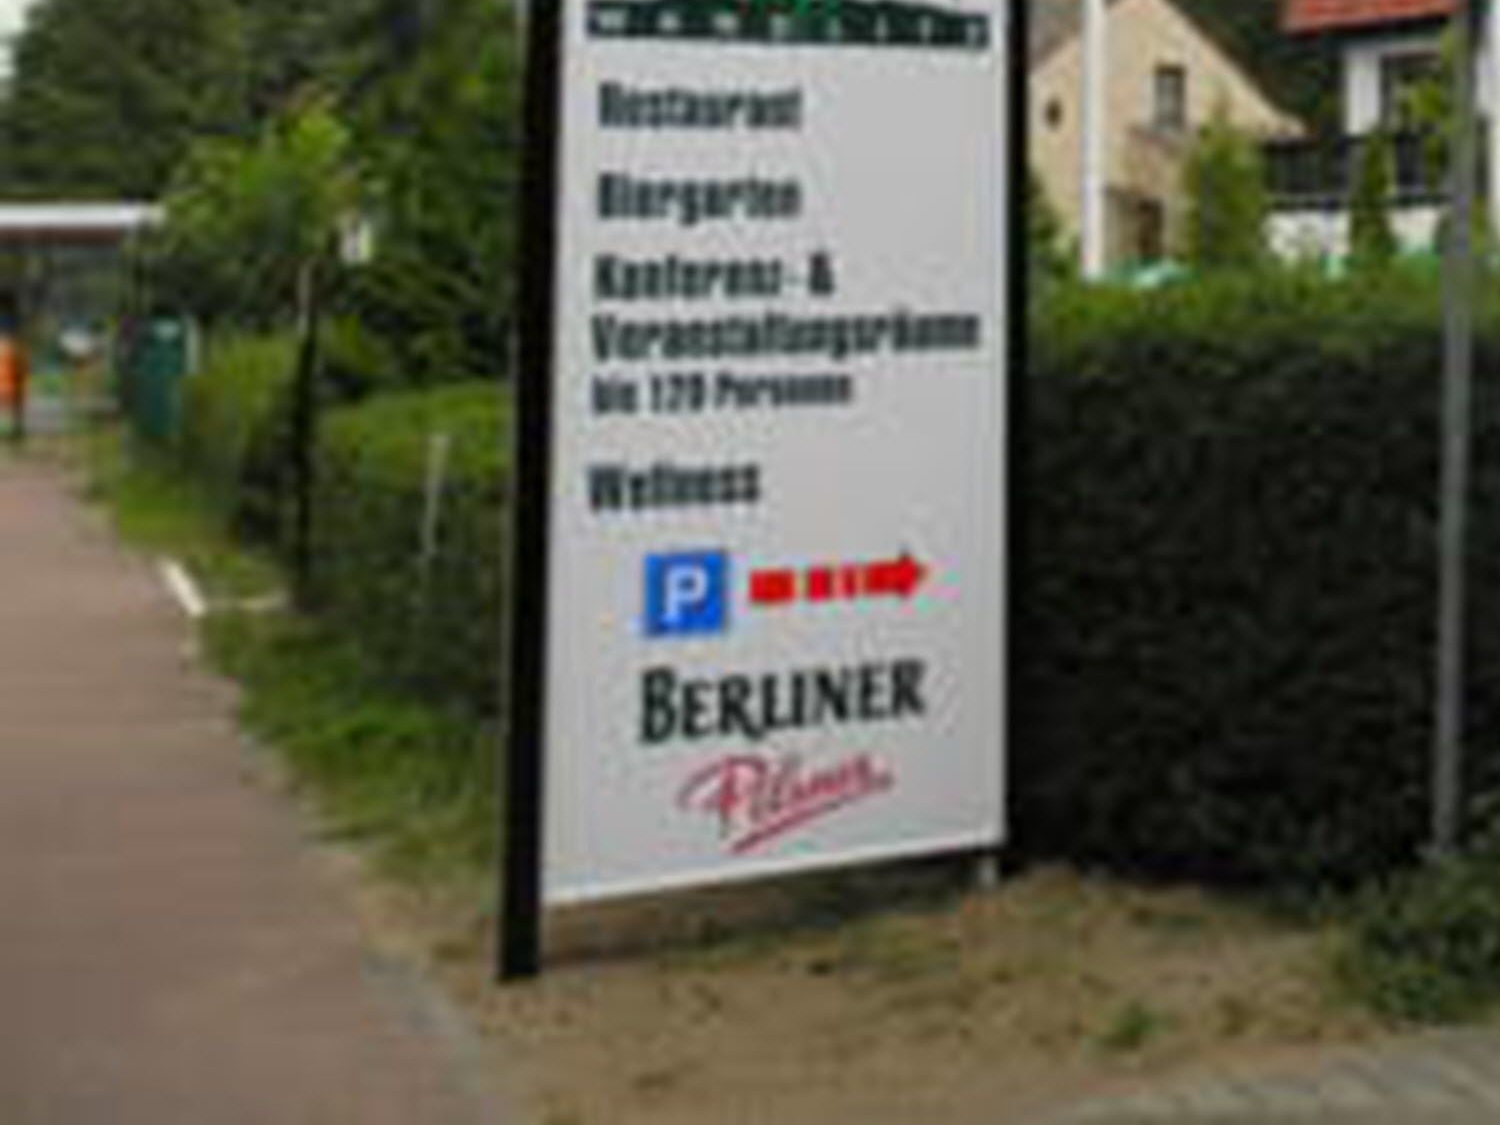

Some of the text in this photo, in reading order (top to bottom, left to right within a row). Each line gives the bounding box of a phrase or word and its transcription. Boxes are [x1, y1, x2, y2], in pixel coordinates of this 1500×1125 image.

[599, 83, 803, 129] Restaurant
[599, 172, 802, 226] Biergarten
[596, 252, 836, 300] Konferenz- &
[591, 310, 981, 359] Veranstaltungsräume
[591, 375, 638, 414] bis
[713, 375, 853, 409] Personen
[587, 464, 760, 512] Wellness
[664, 565, 707, 623] P
[639, 658, 926, 743] BERLINER
[676, 753, 894, 845] Pilsner
